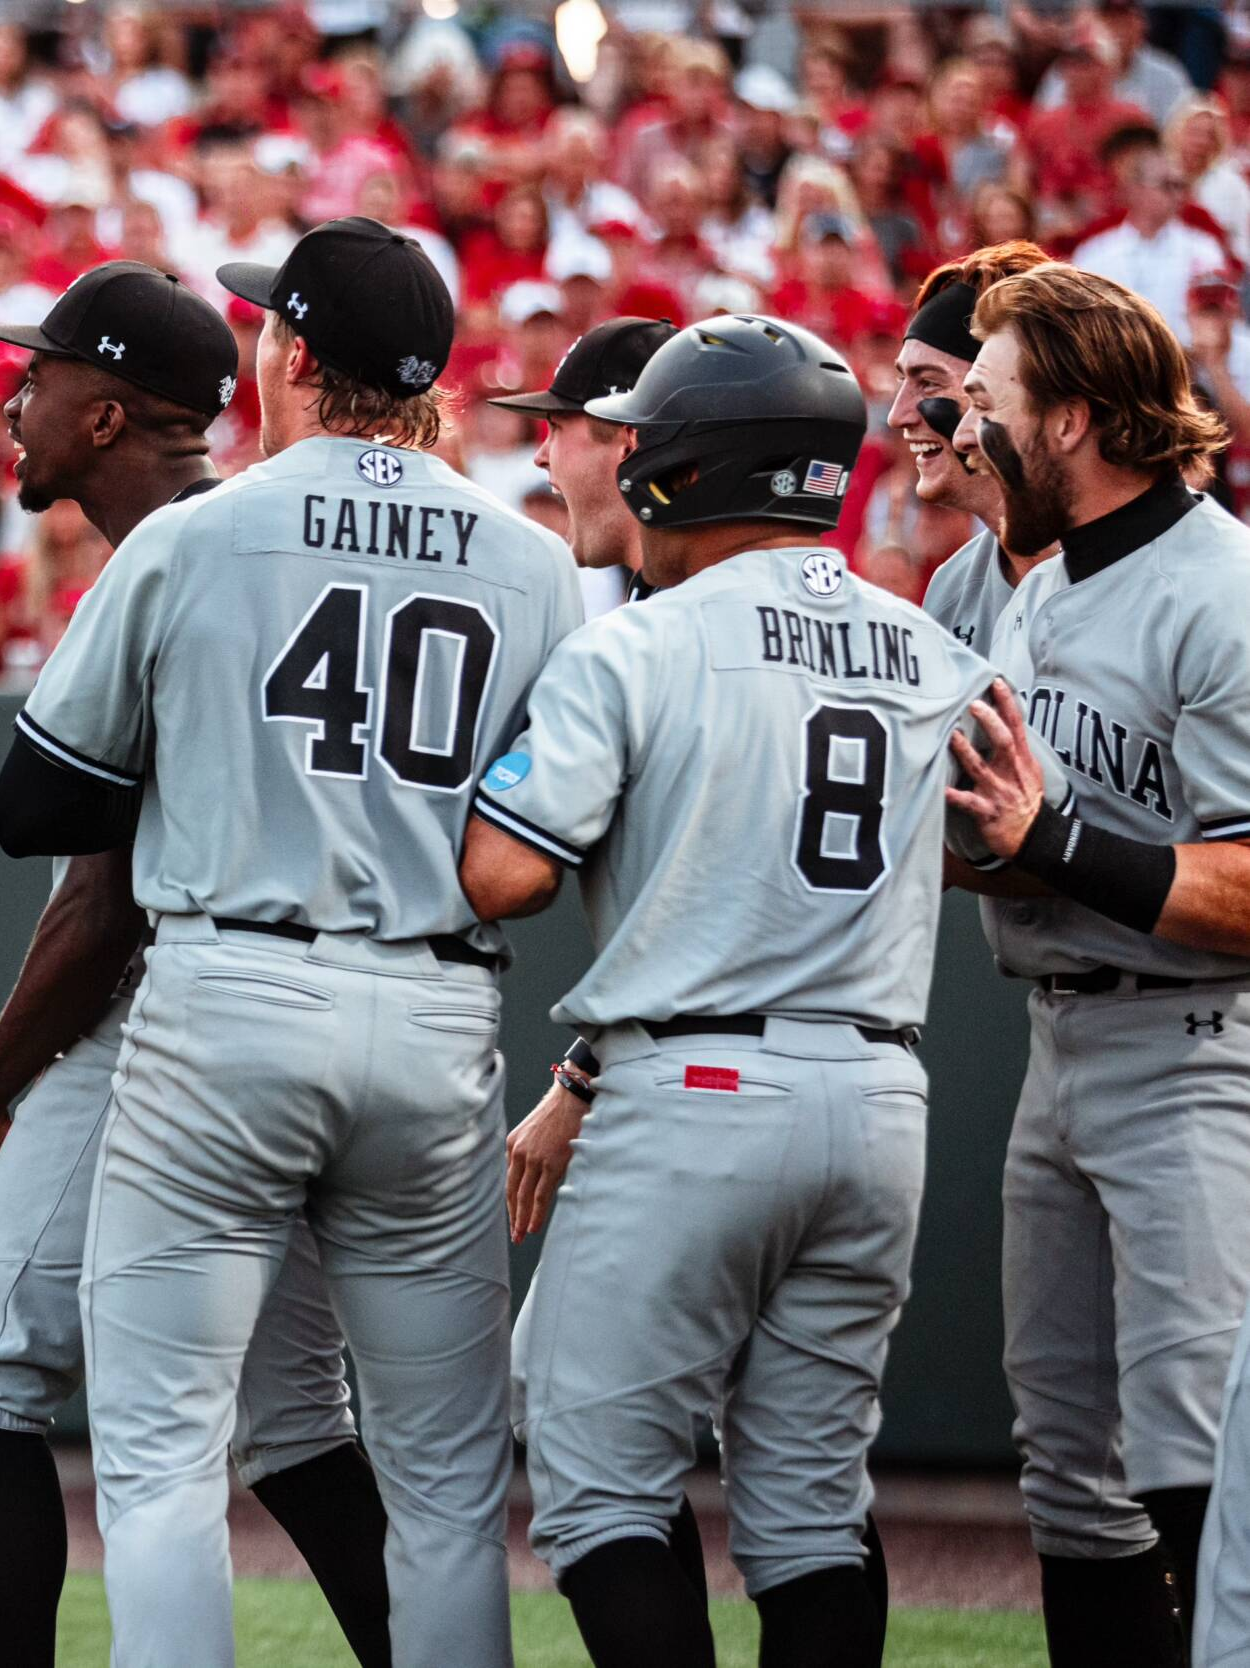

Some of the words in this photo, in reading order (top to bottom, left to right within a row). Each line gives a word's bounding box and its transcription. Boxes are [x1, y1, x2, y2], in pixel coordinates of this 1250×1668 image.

[359, 450, 402, 486] SEC
[303, 494, 478, 566] GAINEY
[803, 555, 842, 595] SEC
[755, 605, 920, 687] BRINLING
[261, 582, 501, 794] 40
[1020, 686, 1174, 823] OLINA
[790, 700, 892, 895] 8
